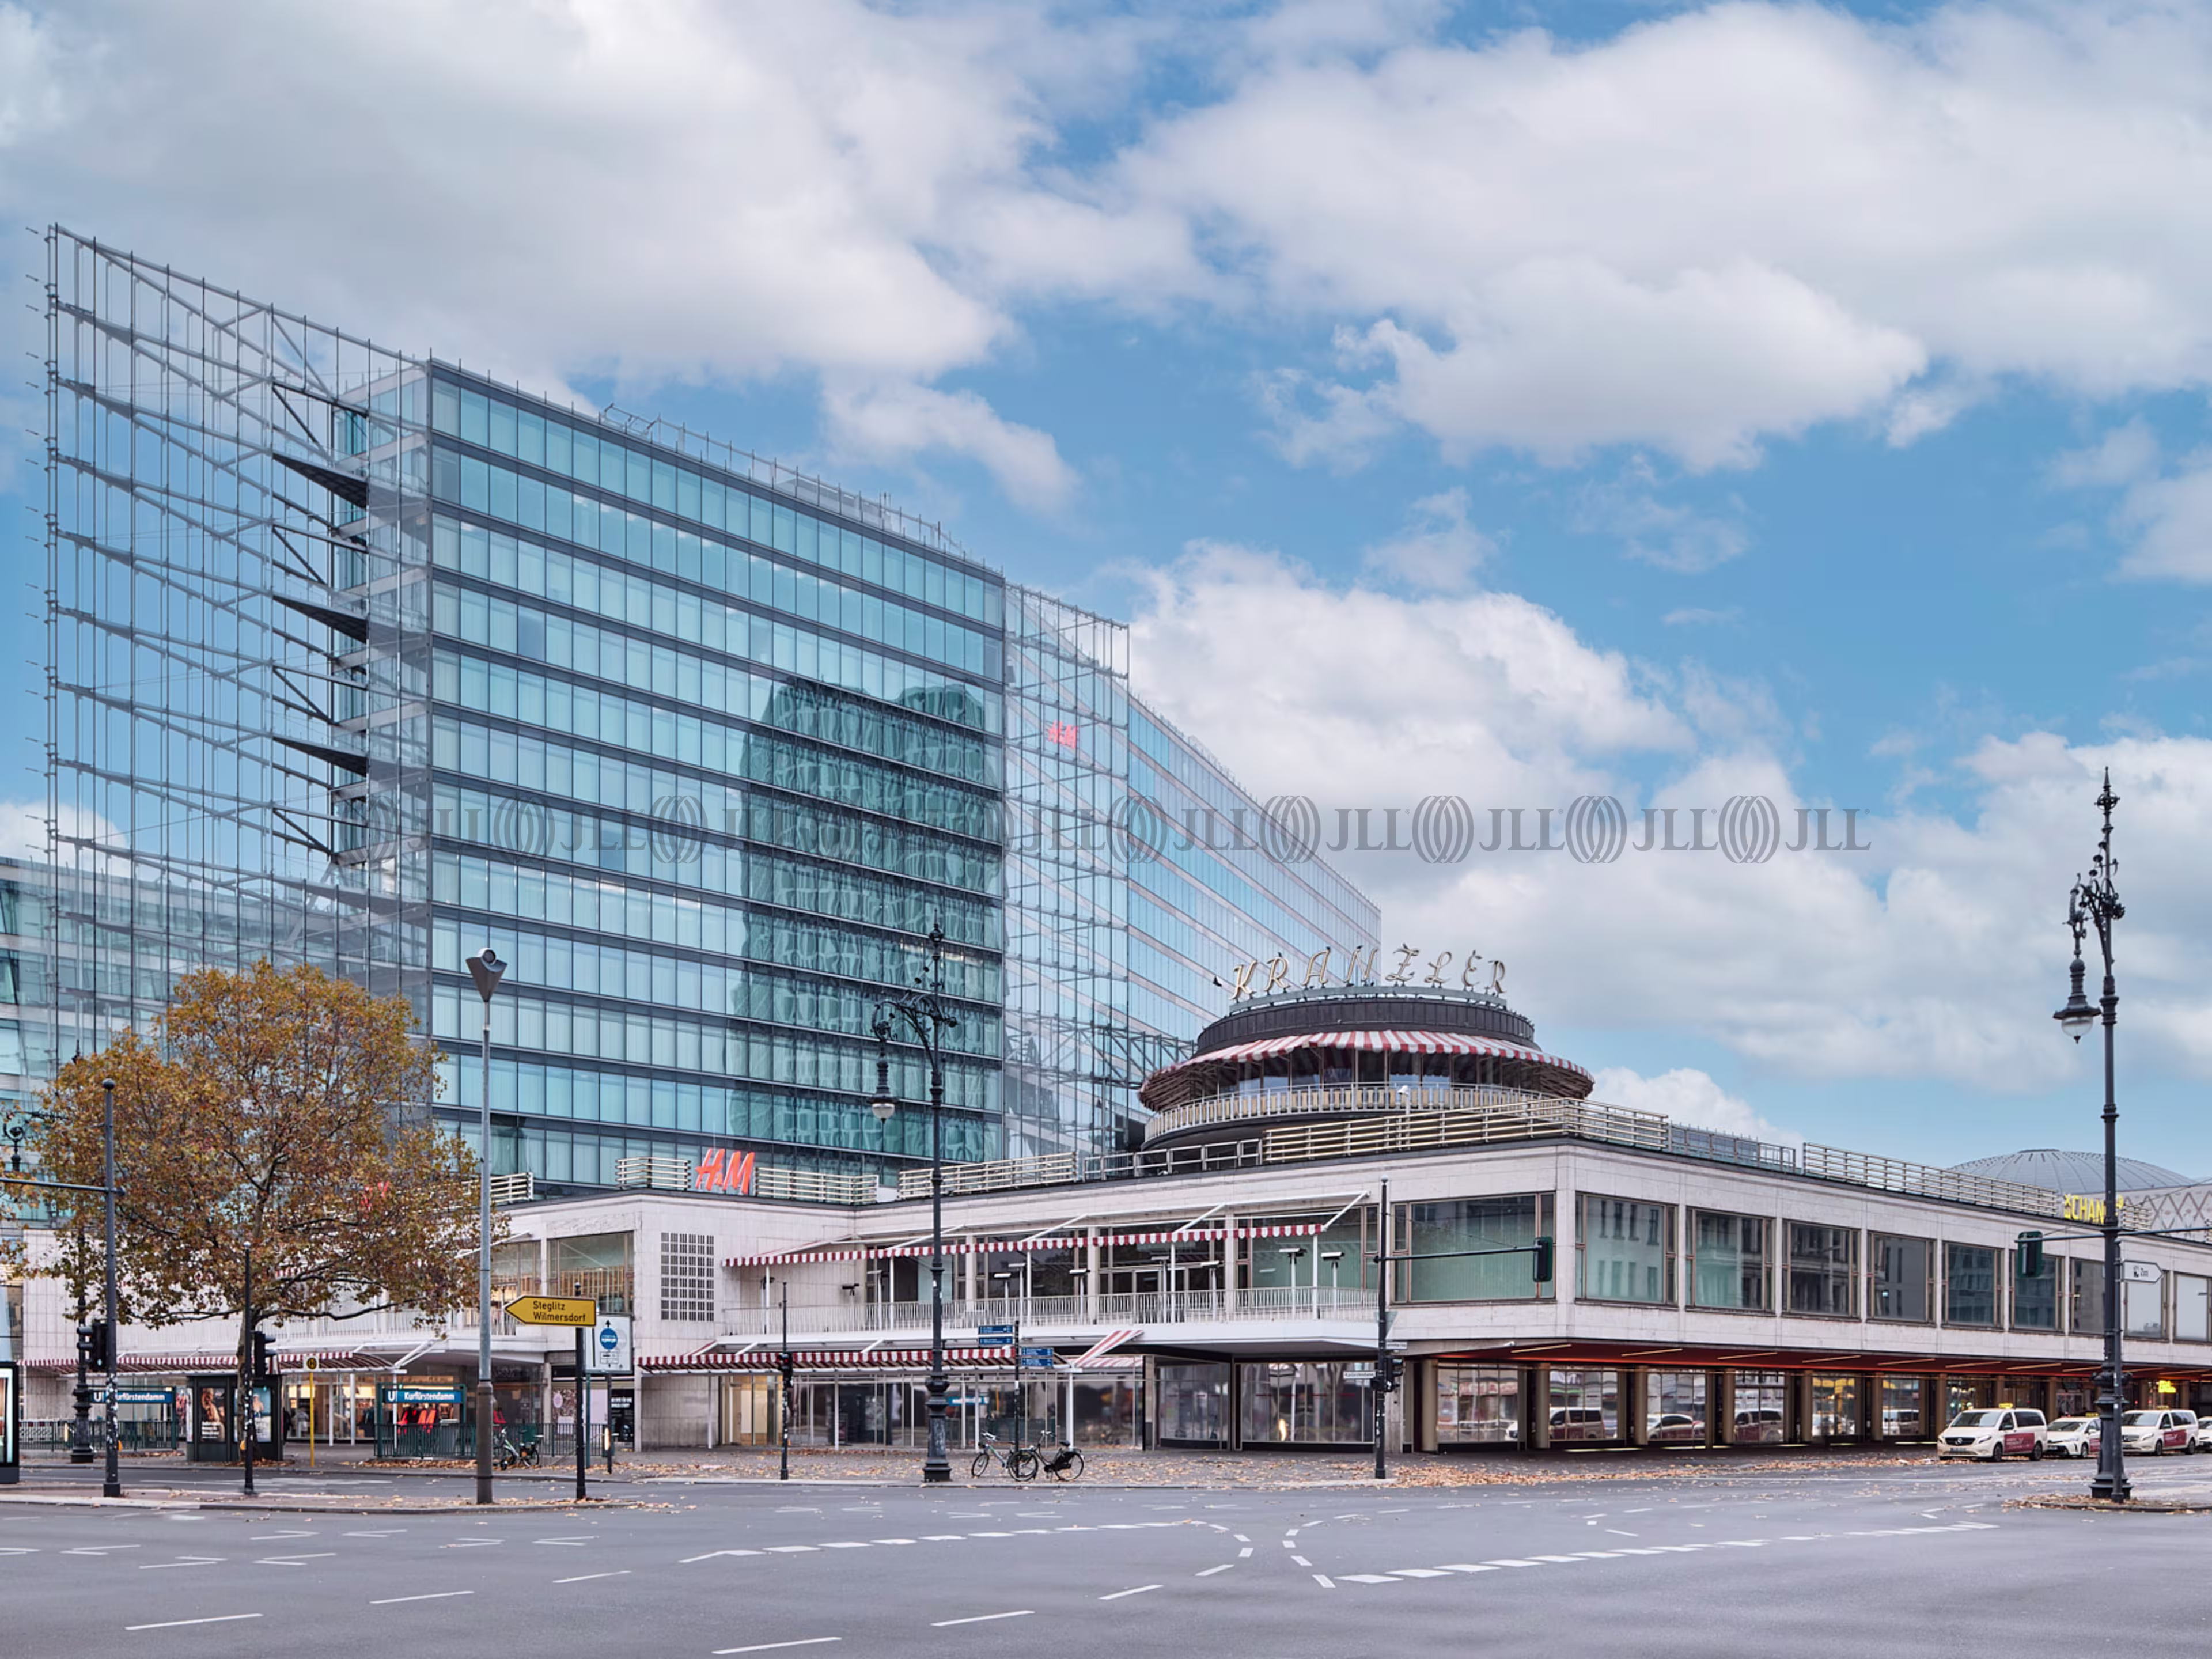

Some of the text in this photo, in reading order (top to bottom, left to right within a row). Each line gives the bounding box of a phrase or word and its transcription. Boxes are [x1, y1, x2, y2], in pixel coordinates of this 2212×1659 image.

[1232, 946, 1507, 1000] KRANZLER
[695, 1147, 755, 1194] H&M
[533, 1301, 565, 1312] Steglitz
[533, 1312, 585, 1322] Wilmersdorf
[93, 1392, 165, 1402] U urfürstendamm
[387, 1391, 455, 1402] U Kurfürstendamm
